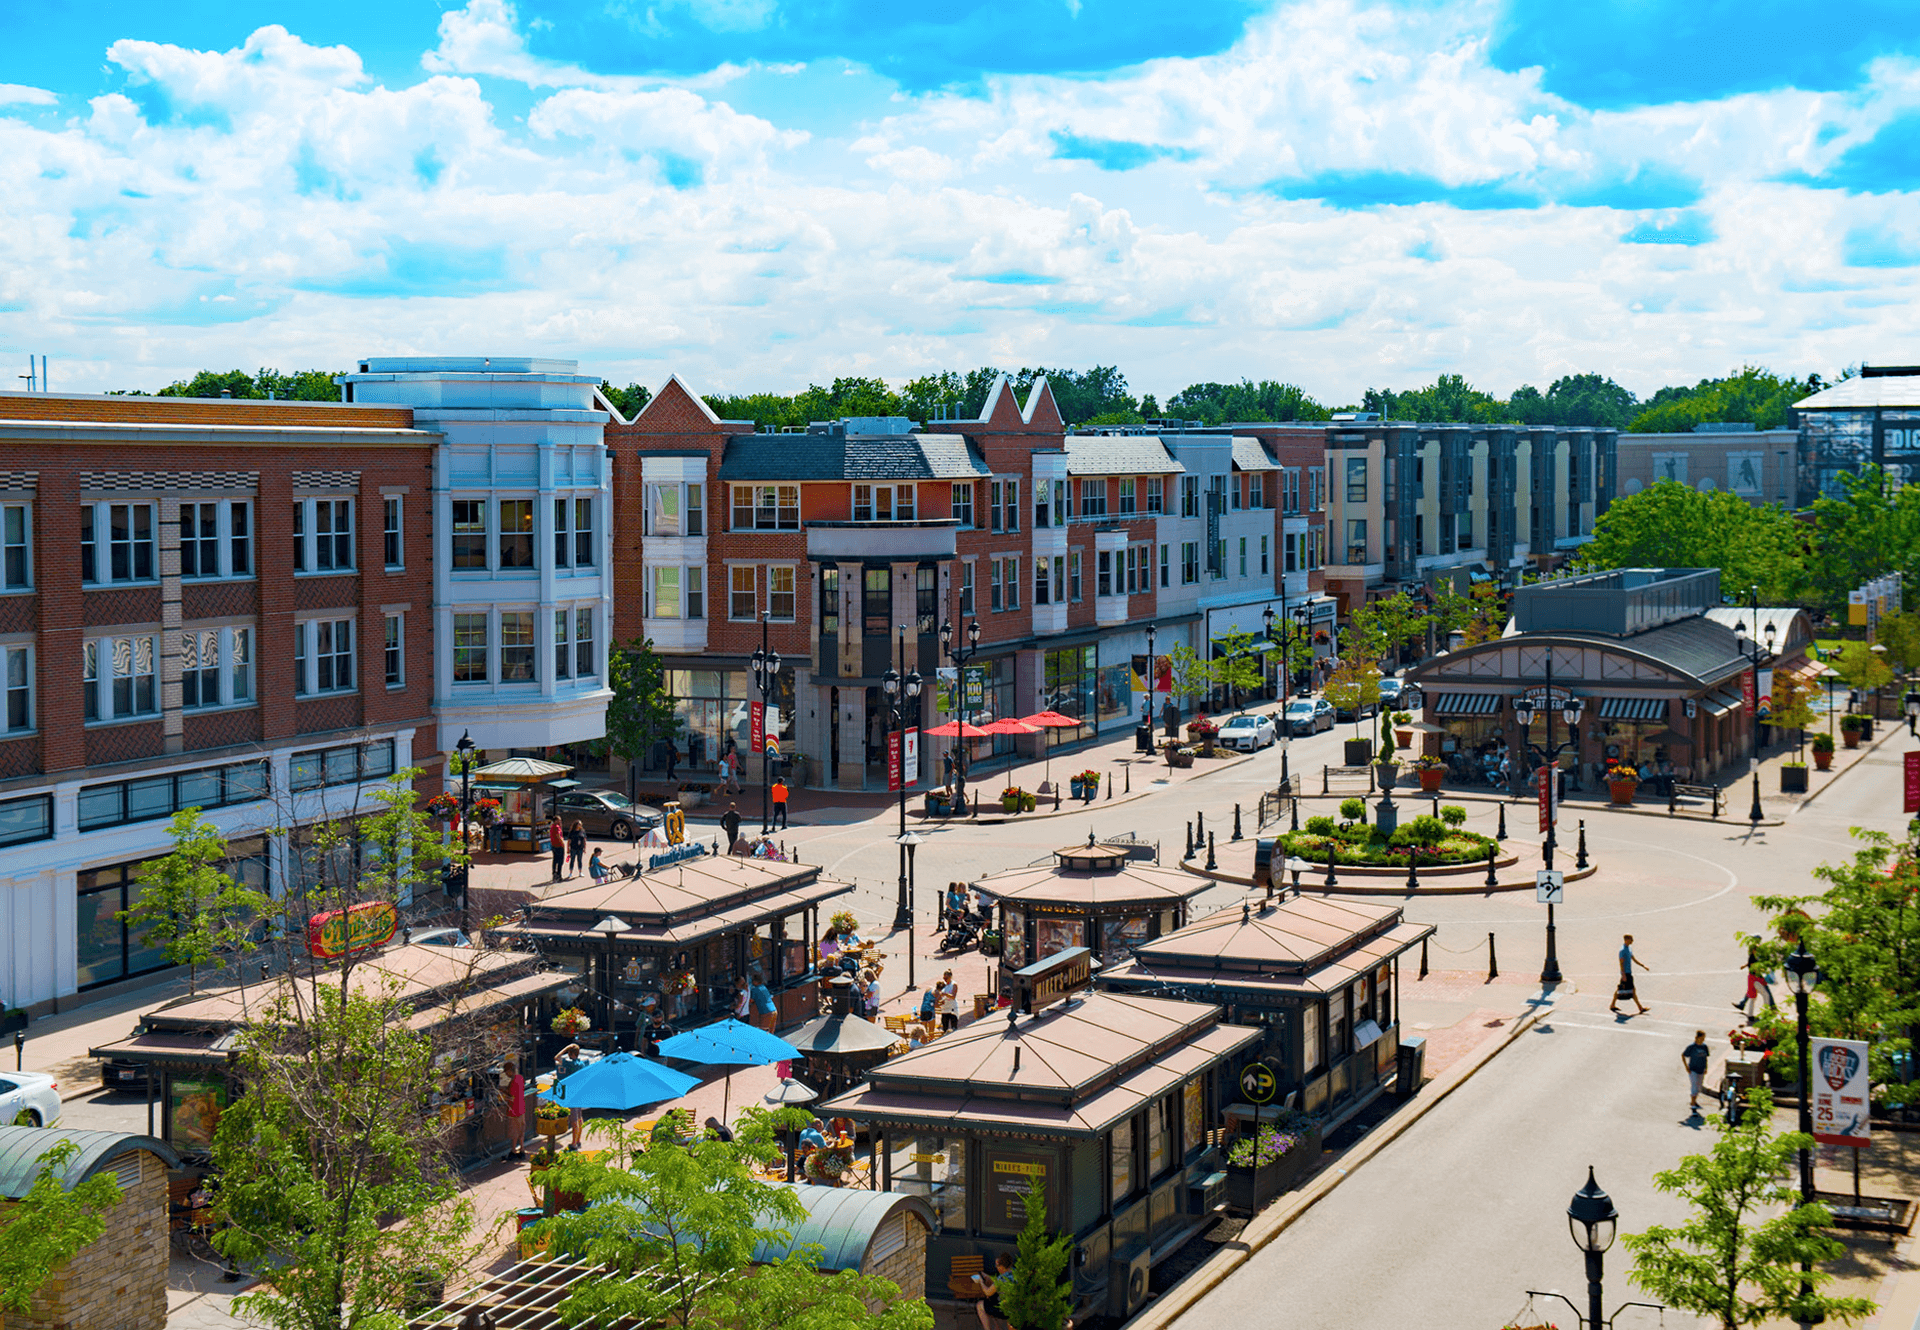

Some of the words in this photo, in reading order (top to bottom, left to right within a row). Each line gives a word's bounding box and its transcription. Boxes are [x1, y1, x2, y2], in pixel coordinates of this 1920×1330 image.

[966, 682, 982, 696] 100
[1257, 1073, 1273, 1094] P
[1817, 1106, 1834, 1121] 25
